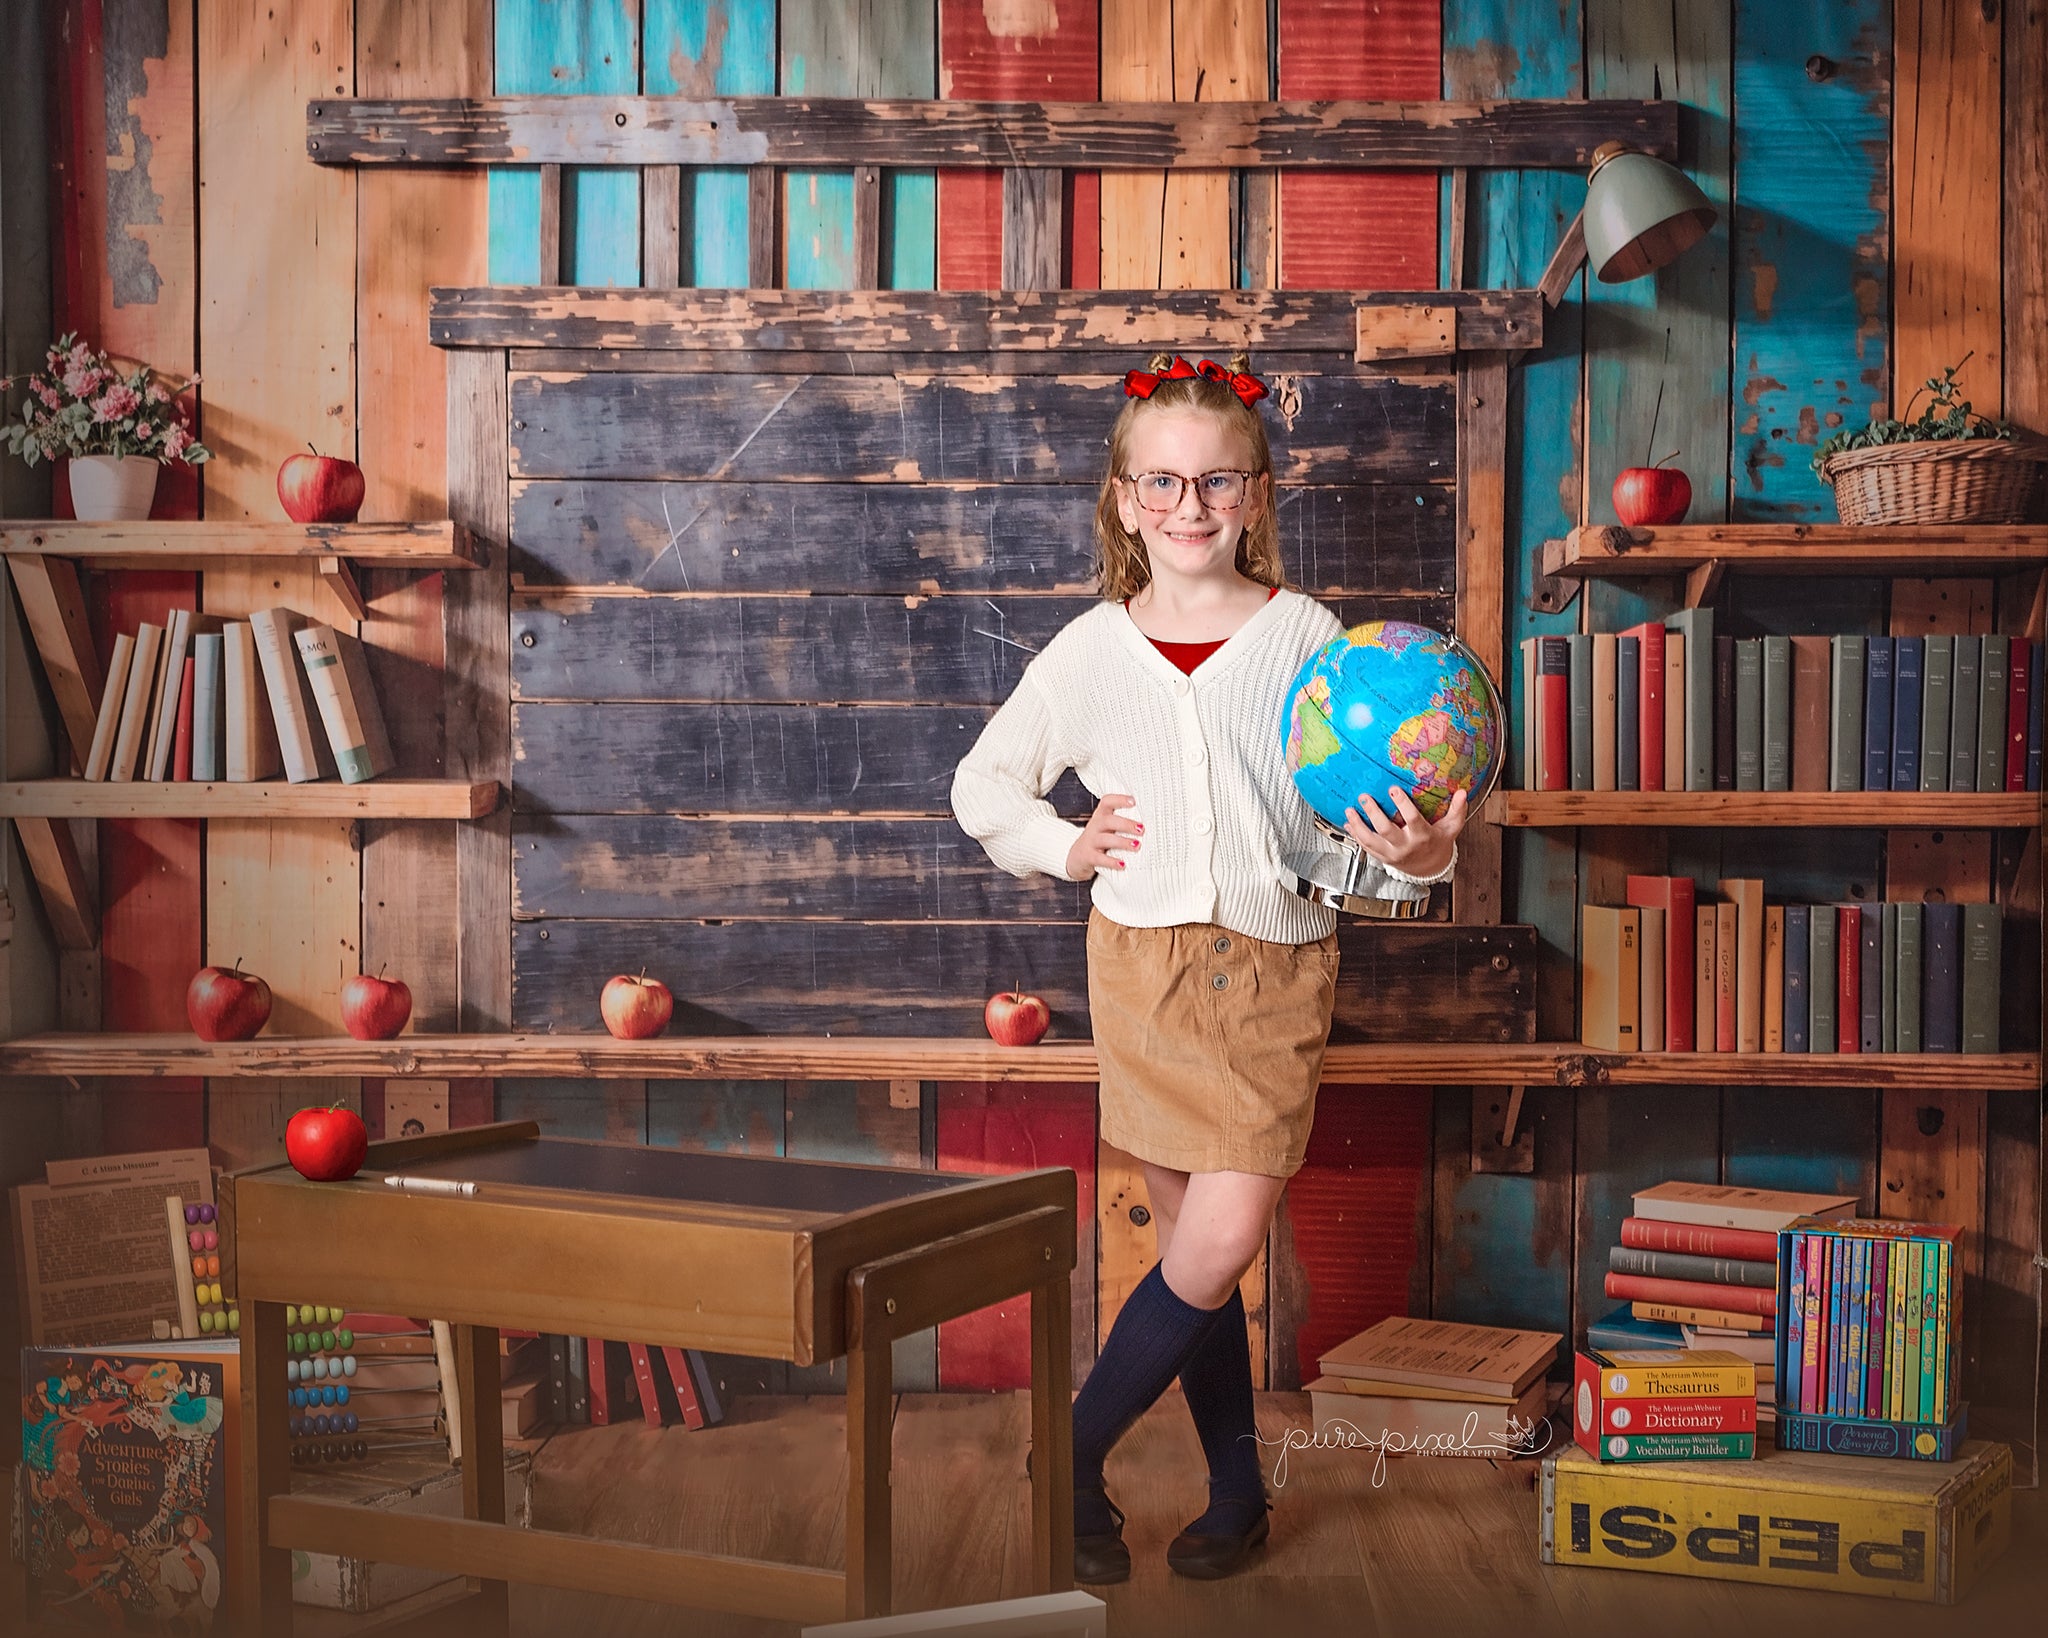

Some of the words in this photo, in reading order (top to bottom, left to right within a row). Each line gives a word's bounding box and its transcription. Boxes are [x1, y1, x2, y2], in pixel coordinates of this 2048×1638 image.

[1805, 1320, 1818, 1367] MATILDA
[1850, 1324, 1861, 1359] CHARLIE
[1908, 1328, 1918, 1347] BOY
[1870, 1333, 1881, 1369] WITCHES
[1661, 1371, 1719, 1379] Merriam-Webster
[1645, 1380, 1720, 1394] Thesaurus
[1663, 1404, 1722, 1412] Merriam-Webster
[1645, 1413, 1723, 1430] Dictionary
[1660, 1436, 1719, 1444] Merriam-Webster
[1841, 1425, 1888, 1440] Personal
[1635, 1445, 1691, 1457] Vocabulary
[1692, 1444, 1729, 1455] Builder
[1836, 1438, 1872, 1453] Library
[1872, 1439, 1890, 1451] Kit
[1571, 1503, 1926, 1581] PEPSI
